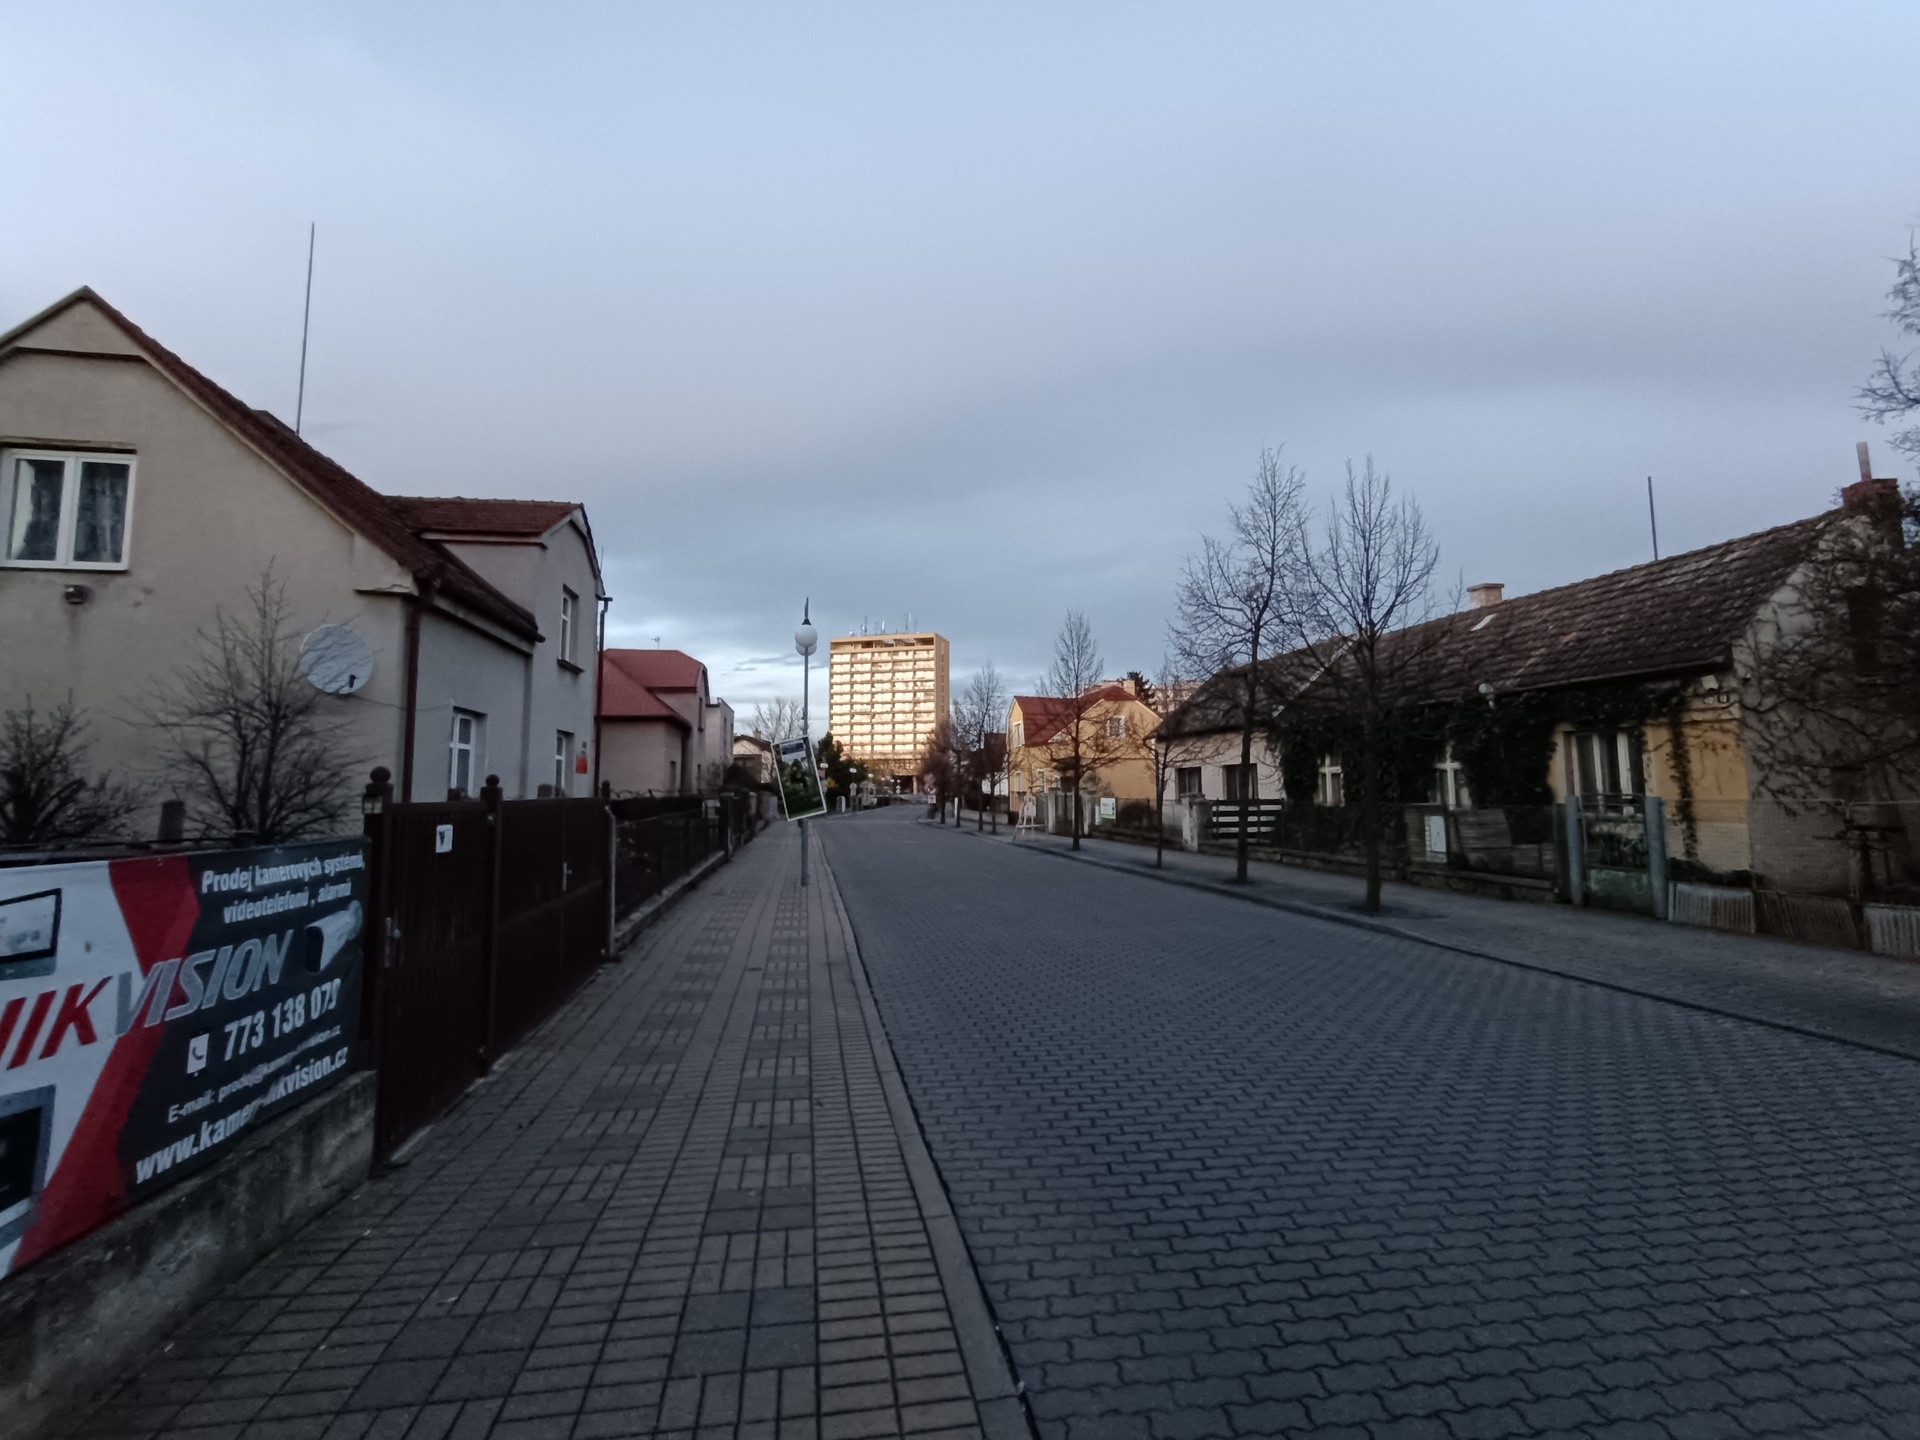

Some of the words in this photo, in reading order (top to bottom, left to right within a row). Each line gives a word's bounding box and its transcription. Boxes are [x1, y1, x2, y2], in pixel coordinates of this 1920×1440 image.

[201, 865, 252, 894] Prodej
[255, 856, 322, 886] kamerových
[224, 1009, 266, 1062] 773
[271, 992, 306, 1039] 138
